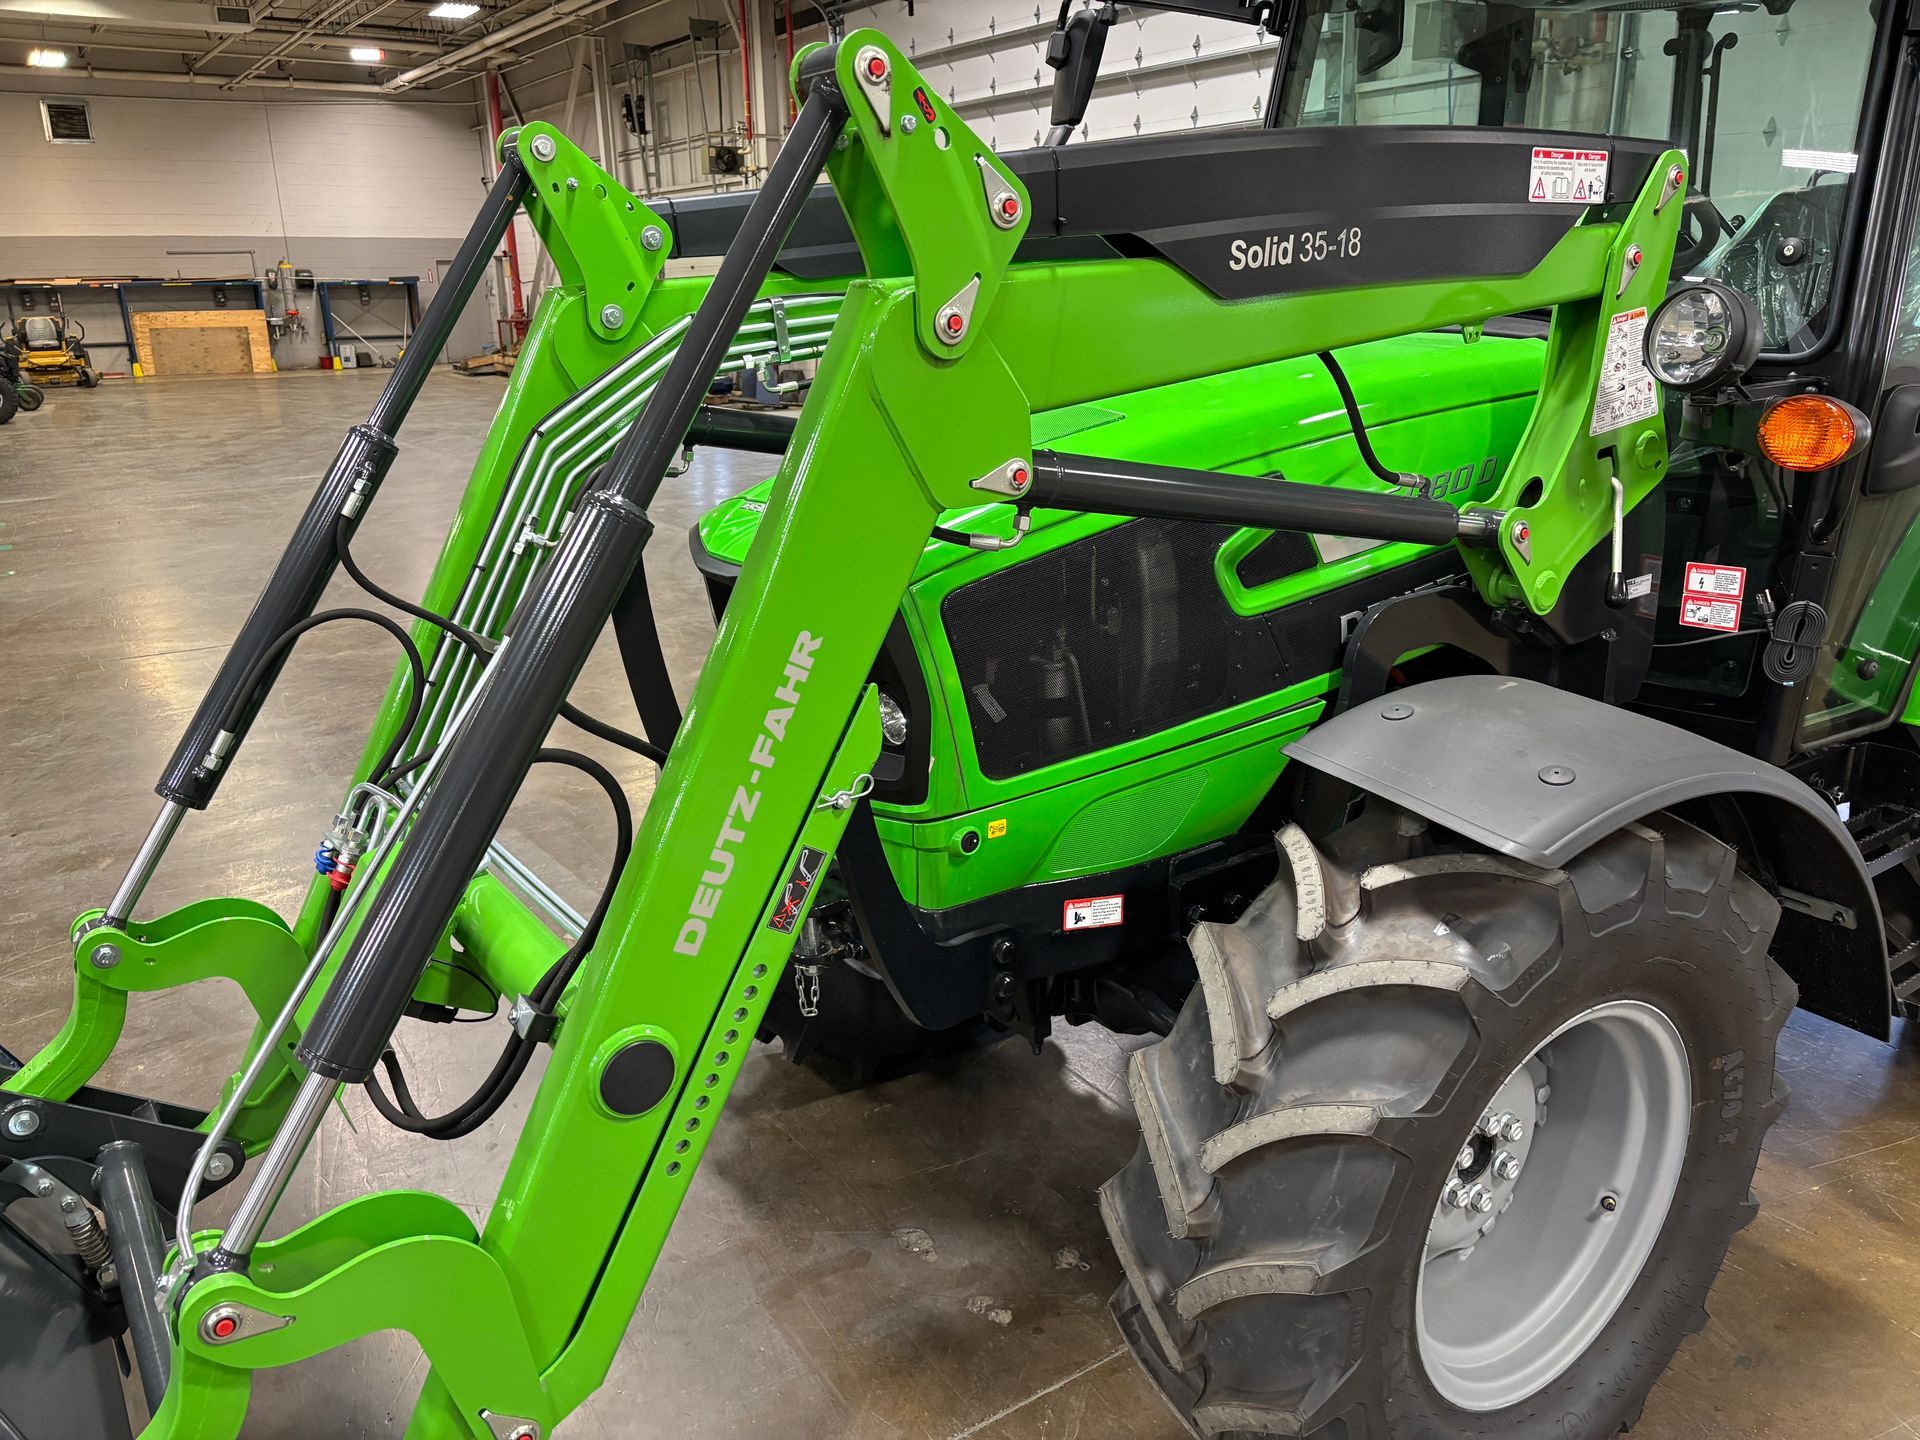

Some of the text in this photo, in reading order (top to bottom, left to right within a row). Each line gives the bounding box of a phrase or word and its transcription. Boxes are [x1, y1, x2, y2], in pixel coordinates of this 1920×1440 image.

[1229, 227, 1362, 271] Solid 35-18
[672, 630, 824, 957] DEUTZ-FAHR
